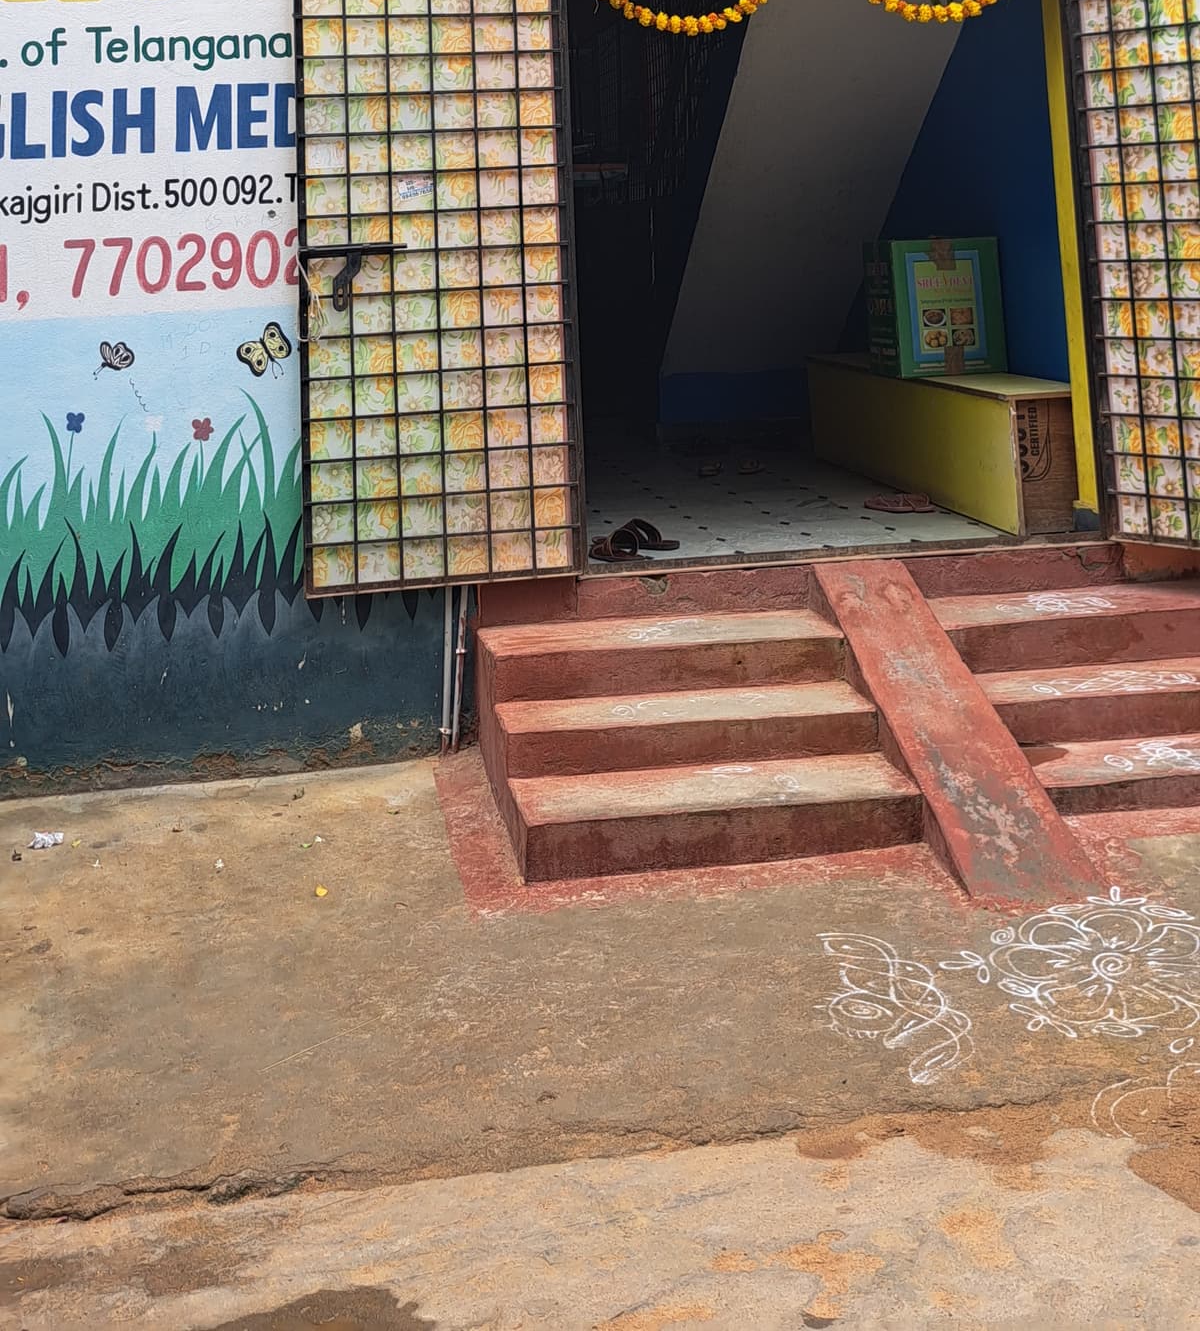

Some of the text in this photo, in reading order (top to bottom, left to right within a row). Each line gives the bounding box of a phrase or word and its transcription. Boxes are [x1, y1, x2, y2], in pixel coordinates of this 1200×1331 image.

[21, 25, 293, 71] of Telangana
[0, 86, 156, 160] LISH
[92, 181, 159, 213] Dist.
[164, 178, 217, 209] 500
